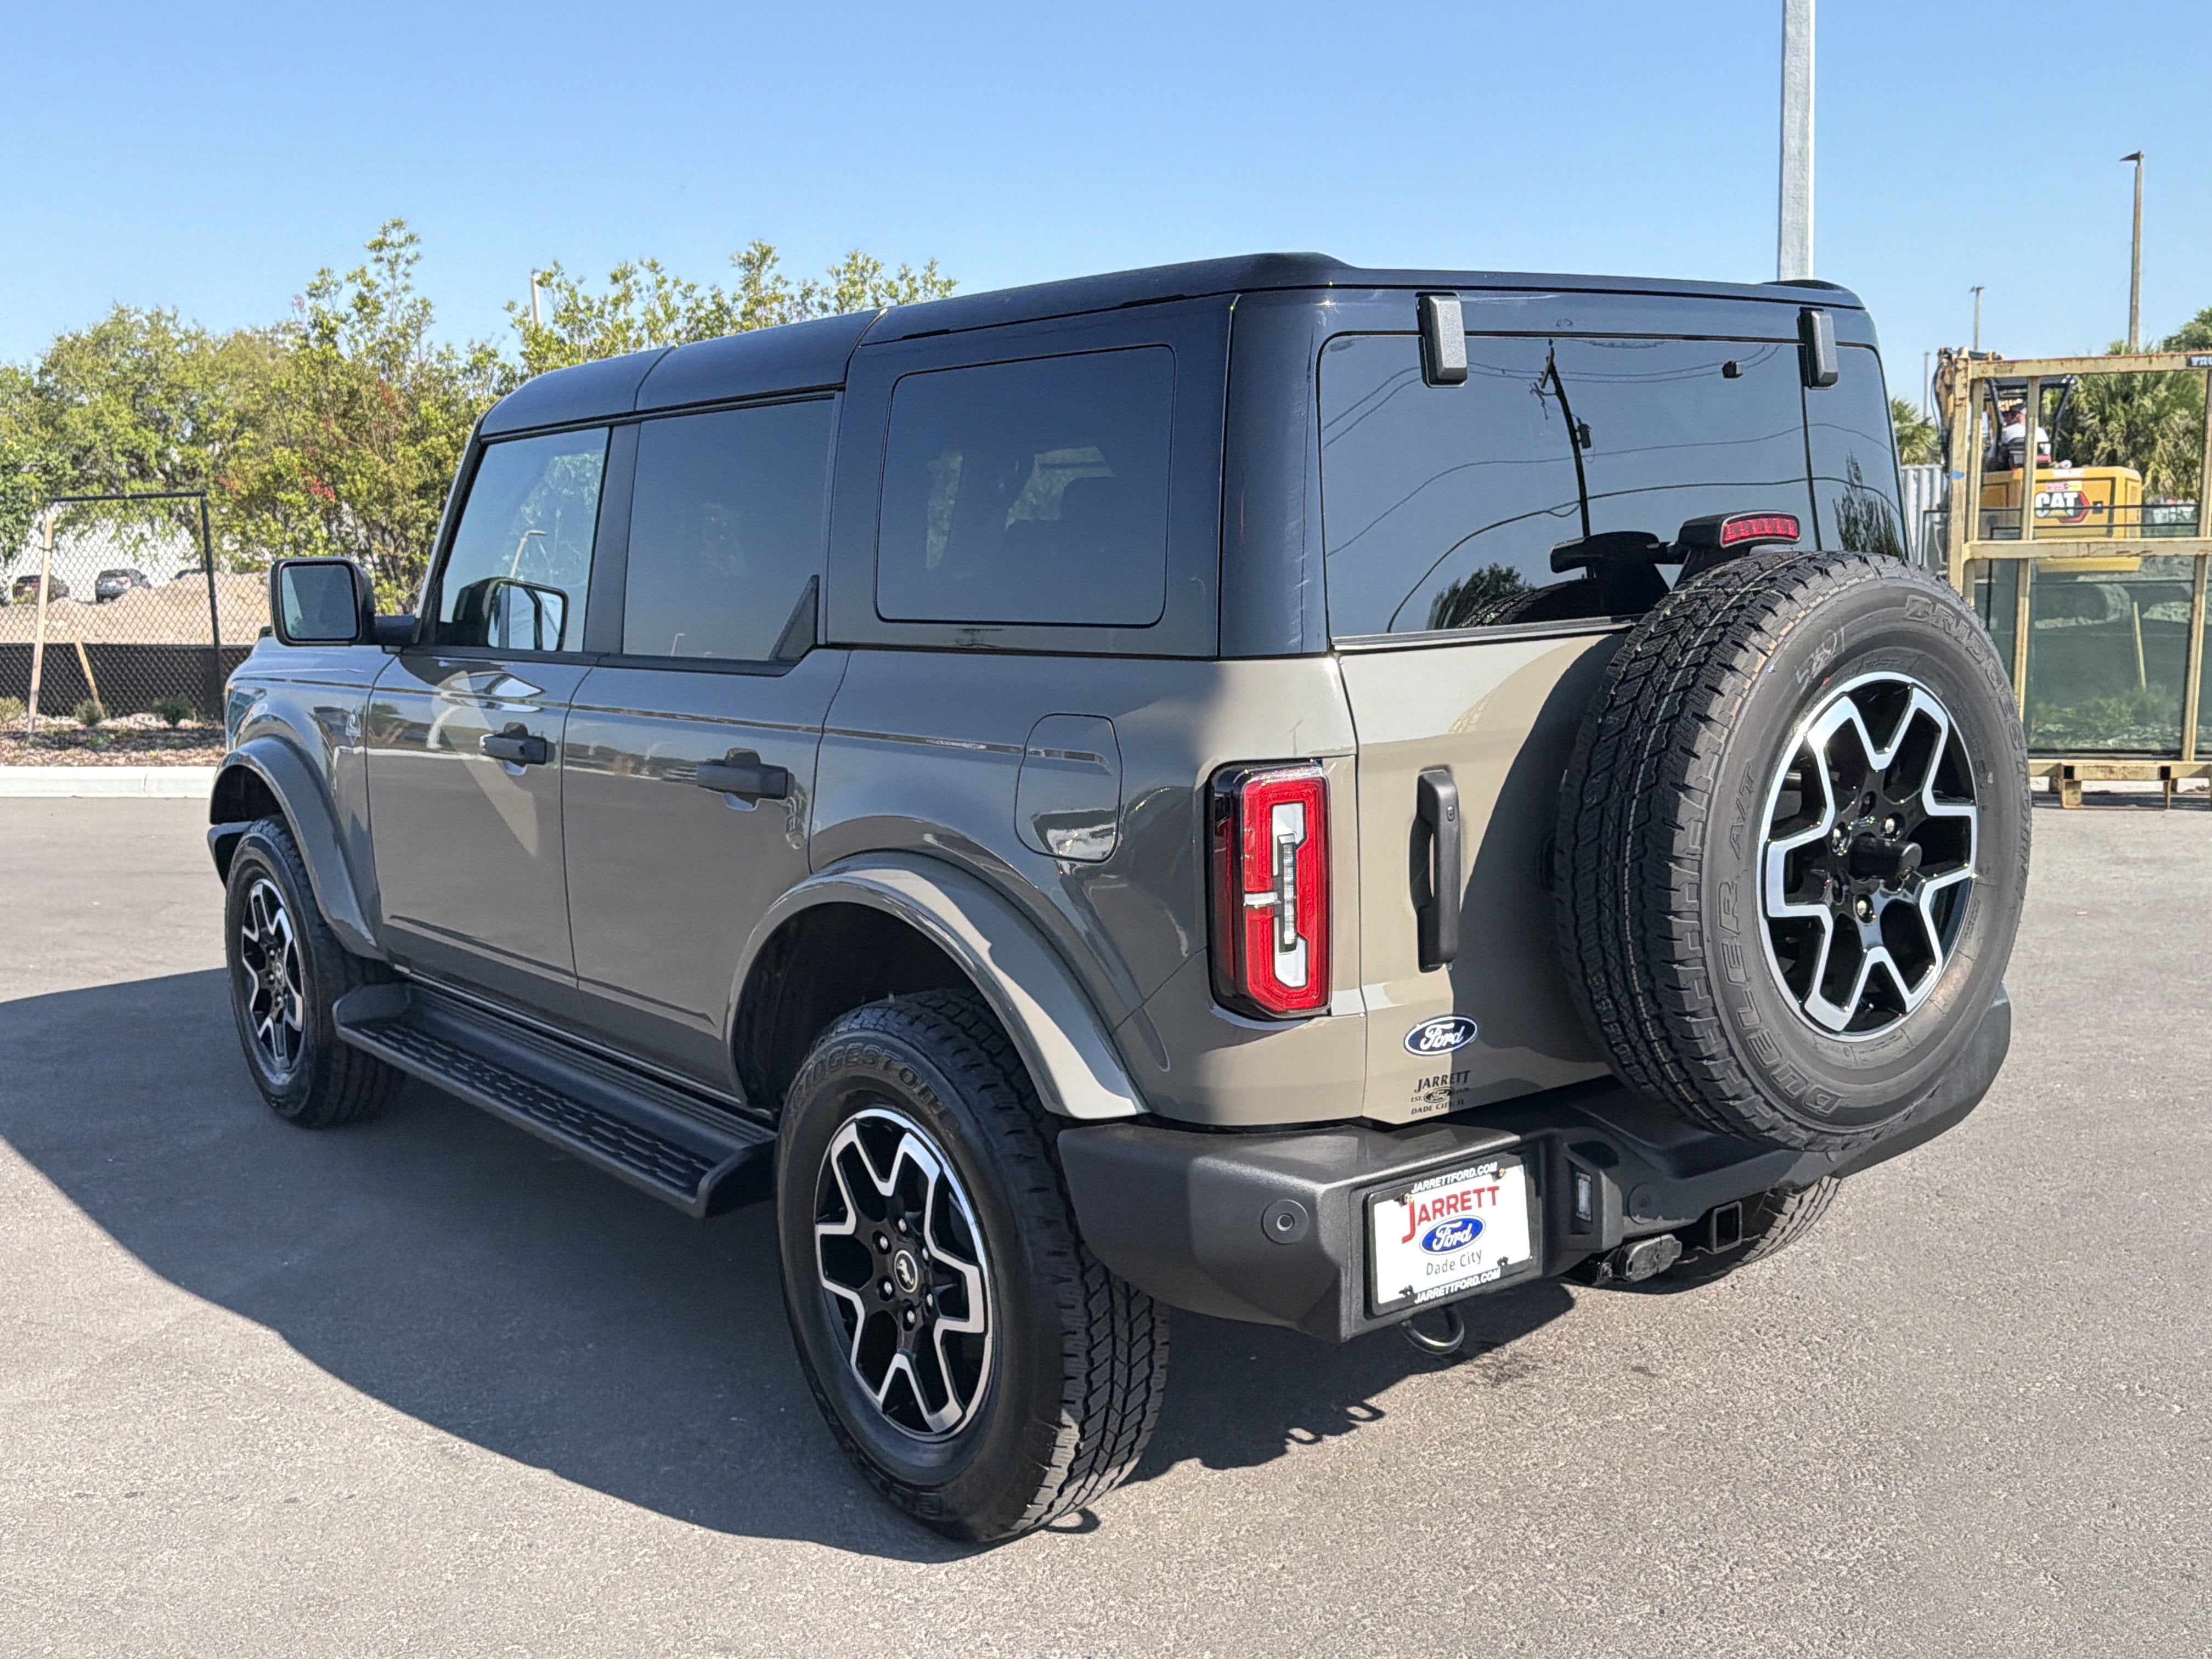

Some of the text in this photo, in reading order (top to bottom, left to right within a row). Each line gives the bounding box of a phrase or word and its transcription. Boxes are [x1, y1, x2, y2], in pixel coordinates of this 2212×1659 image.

[2035, 492, 2078, 517] CAT
[1718, 881, 1842, 1116] DUELER
[1420, 1023, 1465, 1050] Ford
[1414, 1070, 1471, 1093] JARRETT
[1411, 1105, 1433, 1115] DADE
[1411, 1161, 1498, 1193] JARRETTFORD.COM
[1402, 1186, 1499, 1244] JARRETT
[1432, 1221, 1472, 1251] Ford
[1426, 1250, 1482, 1275] Dade City
[1414, 1267, 1501, 1304] JARRETTFORD.COM
